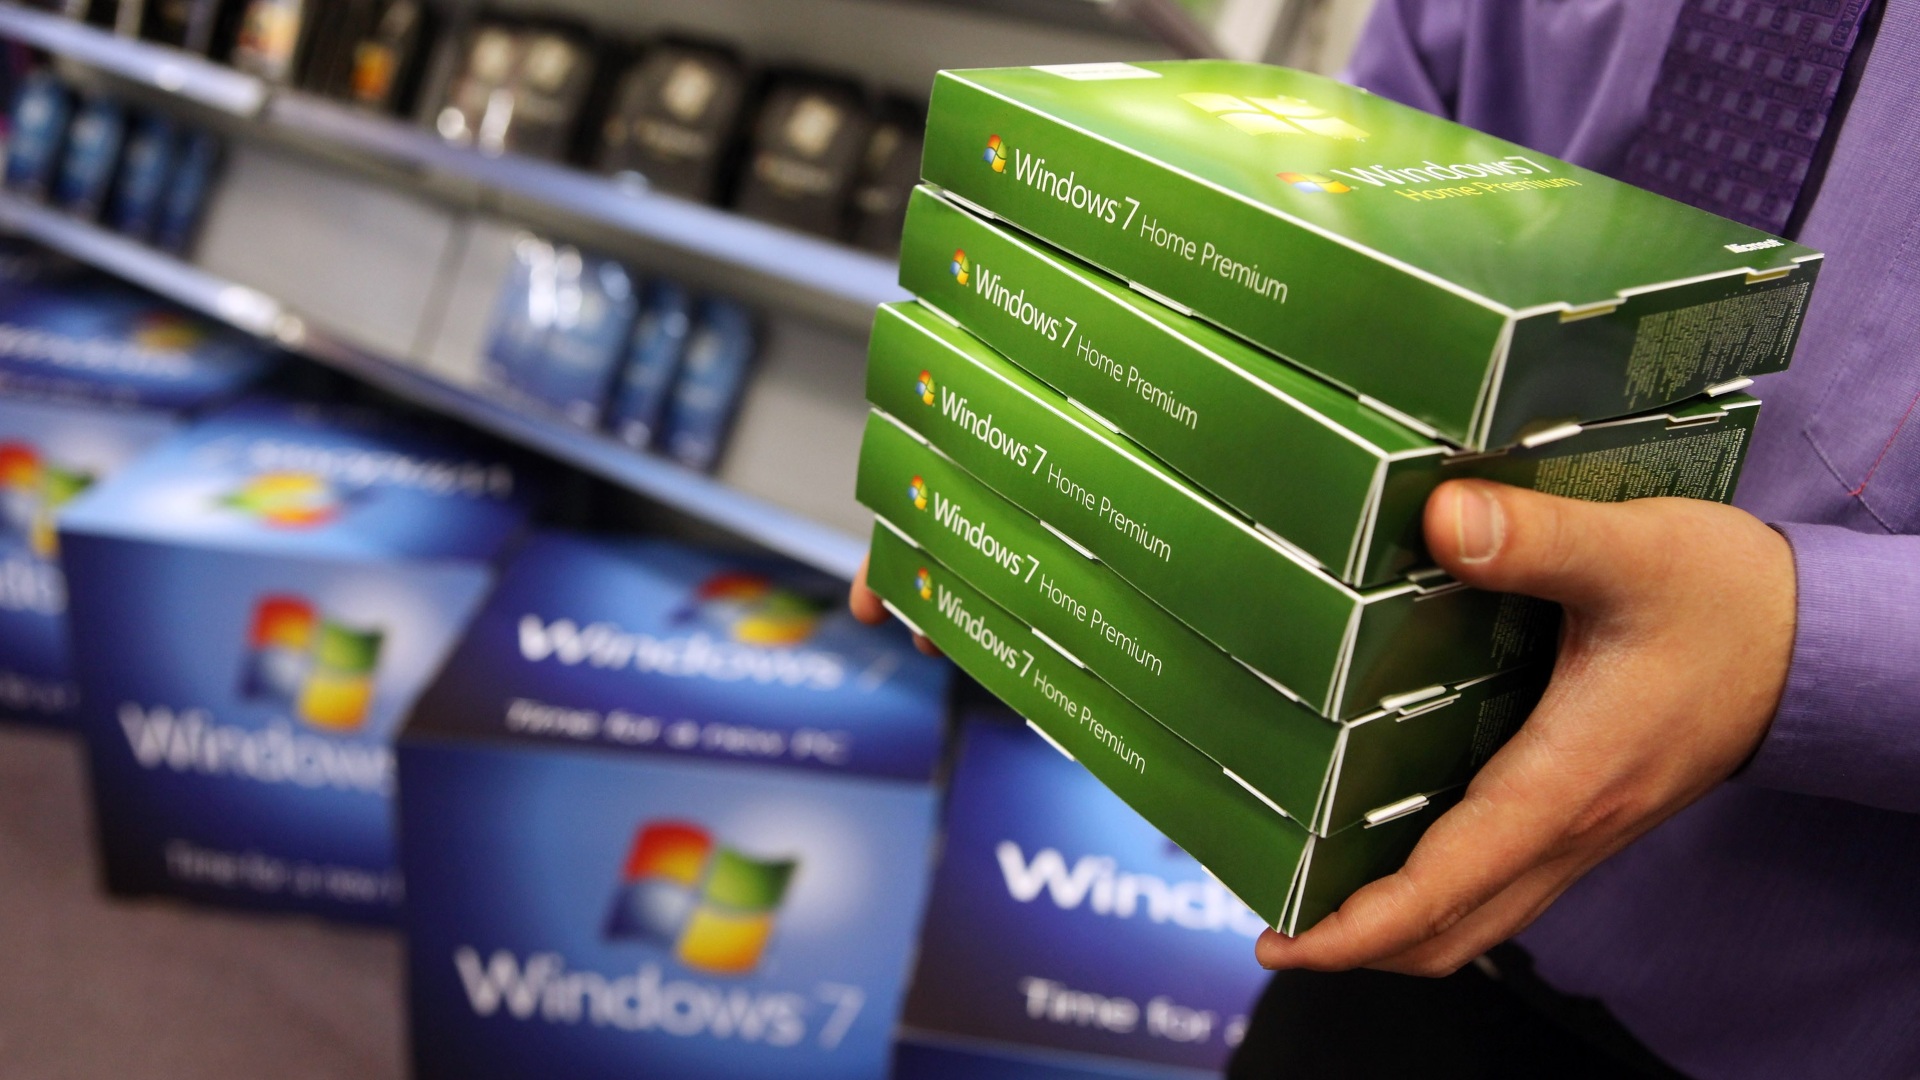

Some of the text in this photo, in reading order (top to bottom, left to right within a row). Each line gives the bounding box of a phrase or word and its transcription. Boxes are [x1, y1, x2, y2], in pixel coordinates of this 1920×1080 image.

[1015, 148, 1288, 304] Windows 7 Home Premium
[1330, 156, 1550, 187] Windows 7
[1395, 176, 1583, 202] Home Premium
[976, 264, 1198, 430] Windows 7 Home Premium
[942, 385, 1172, 562] Windows 7 Home Premium
[935, 492, 1162, 676] Windows 7 Home Premium
[518, 613, 844, 691] Windows
[938, 584, 1146, 774] Windows 7 Home Premium
[454, 944, 866, 1051] Windows 7
[1018, 975, 1140, 1034] Time
[1146, 995, 1217, 1043] for
